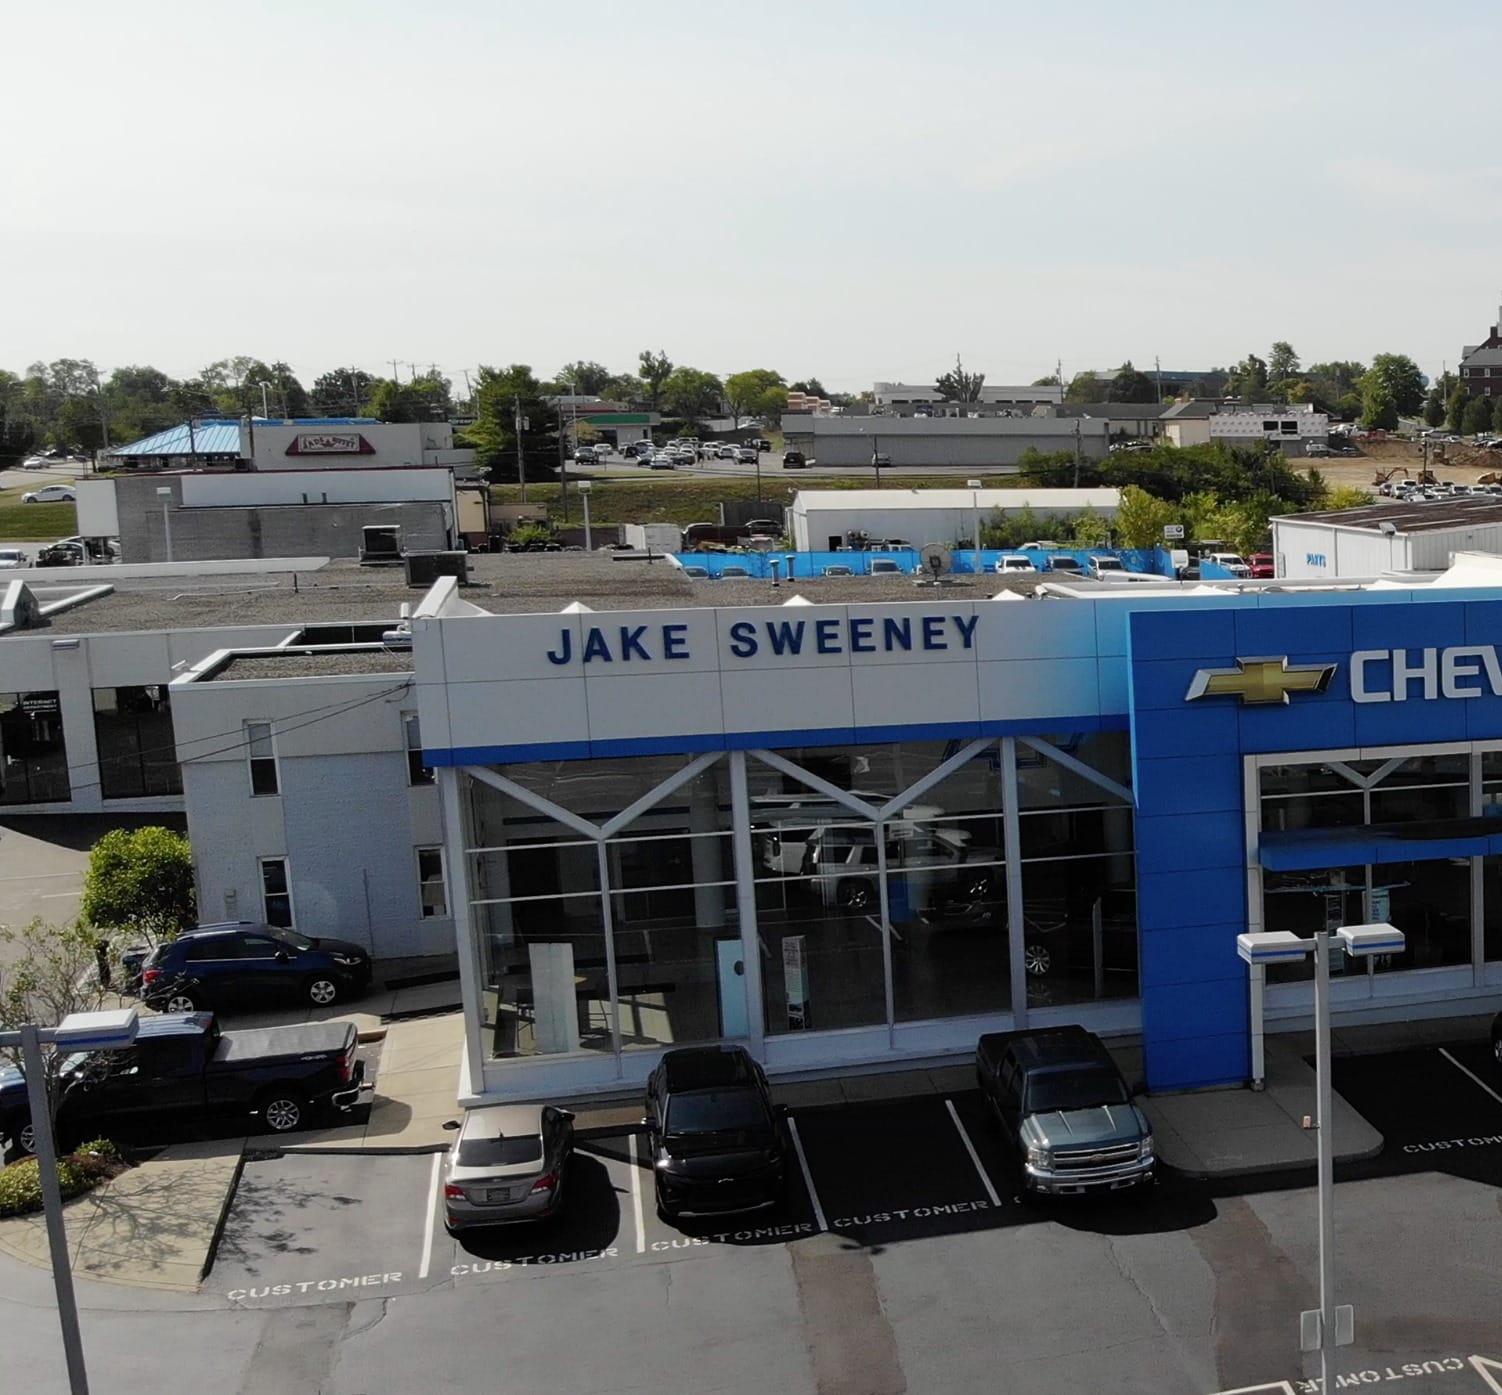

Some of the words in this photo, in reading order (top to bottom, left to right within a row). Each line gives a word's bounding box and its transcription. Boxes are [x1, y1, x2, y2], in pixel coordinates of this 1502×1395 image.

[547, 624, 690, 665] JAKE
[730, 615, 979, 659] SWEENEY
[833, 1199, 990, 1228] CUSTOMER
[651, 1222, 813, 1252] CUSTOMER
[450, 1247, 619, 1276] CUSTOMER
[227, 1271, 403, 1301] CUSTOMER
[1296, 1357, 1465, 1393] CUSTOMR
